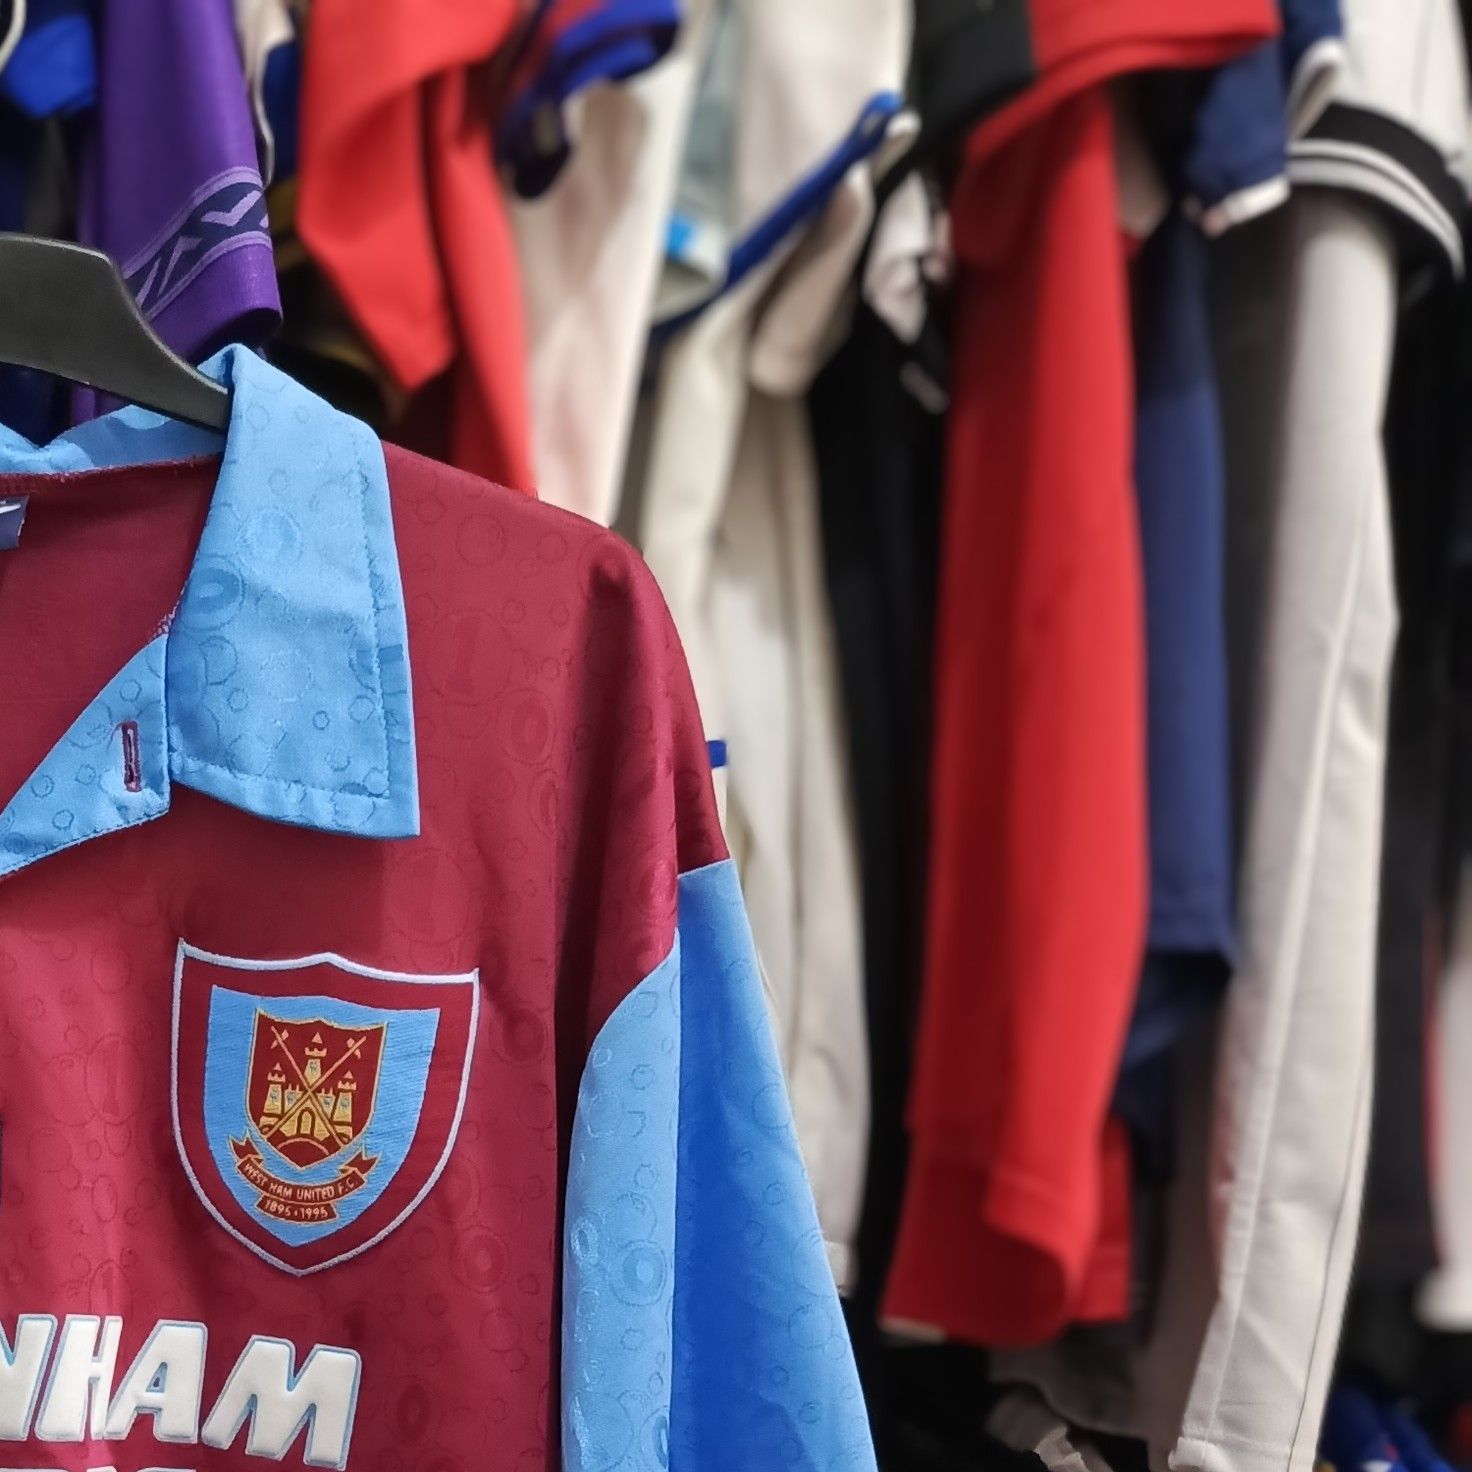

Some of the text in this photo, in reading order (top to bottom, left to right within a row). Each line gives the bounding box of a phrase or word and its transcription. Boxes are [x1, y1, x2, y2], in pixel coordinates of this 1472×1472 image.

[244, 1163, 269, 1187] WEST
[269, 1182, 293, 1200] HAM
[296, 1187, 335, 1202] UNITED
